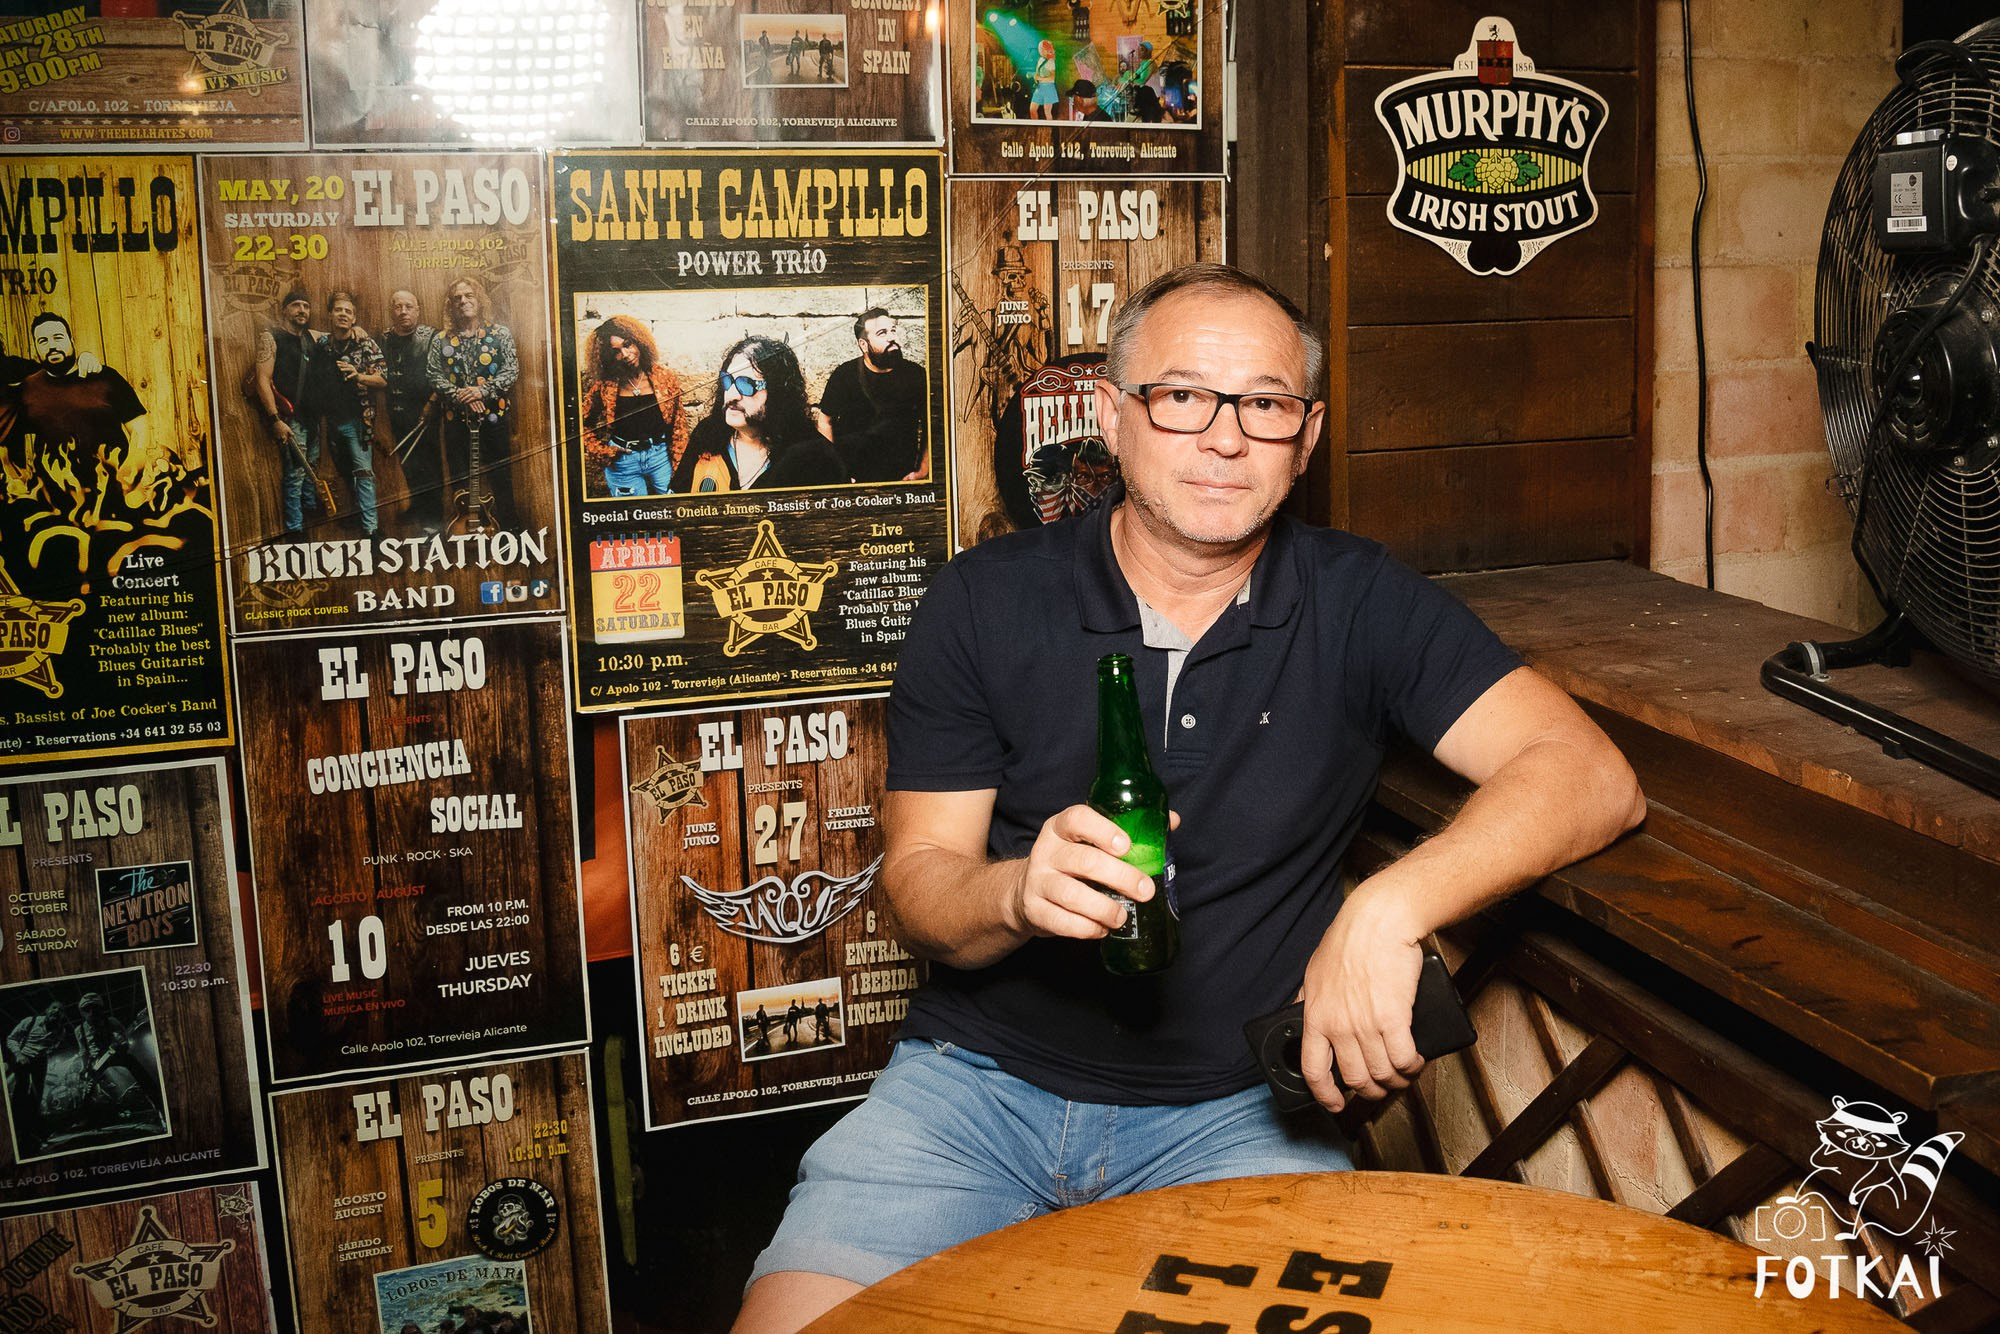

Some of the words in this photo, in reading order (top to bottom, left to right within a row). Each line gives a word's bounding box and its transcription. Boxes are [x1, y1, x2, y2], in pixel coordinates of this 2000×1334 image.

[33, 26, 105, 57] 28TH
[877, 18, 896, 42] IN
[862, 50, 911, 75] SPAIN
[1458, 60, 1475, 70] EST
[1515, 62, 1533, 72] 1856
[233, 68, 287, 87] MUSIC
[685, 117, 720, 127] CALLE
[721, 117, 758, 127] APOLO
[782, 117, 845, 128] TORREVIEJA
[847, 117, 898, 127] ALICANTE
[1395, 89, 1590, 150] MURPHY'S
[1001, 142, 1024, 158] Calle
[1029, 142, 1054, 161] Apolo
[1061, 142, 1084, 160] 102,
[1090, 142, 1137, 162] Torrevieja
[1141, 142, 1177, 159] Alicante
[219, 178, 299, 205] MAY,
[305, 175, 345, 200] 20
[351, 169, 405, 227] EL
[413, 167, 531, 227] PASO
[569, 168, 704, 242] SANTI
[718, 167, 928, 240] CAMPILLO
[224, 211, 340, 228] SATURDAY
[1017, 190, 1058, 241] EL
[1078, 189, 1159, 241] PASO
[1408, 190, 1487, 232] IRISH
[1493, 190, 1579, 232] STOUT
[234, 233, 329, 261] 22-30
[678, 250, 763, 278] POWER
[771, 243, 827, 276] TRÍO
[1062, 260, 1115, 271] PRESENTS
[1000, 301, 1029, 314] JUNE
[1067, 282, 1115, 345] 17
[997, 314, 1032, 327] JUNIO
[582, 510, 628, 525] Special
[633, 507, 672, 521] Guest:
[677, 505, 719, 518] Oneida
[767, 500, 811, 513] Bassist
[815, 498, 827, 511] of
[831, 497, 852, 509] Joe
[855, 494, 902, 507] Cocker's
[905, 492, 936, 504] Band
[871, 523, 903, 537] Live
[249, 538, 373, 583] ROCK
[378, 526, 549, 574] STATION
[600, 543, 673, 569] APRIL
[859, 541, 915, 556] Concert
[126, 554, 165, 569] Live
[112, 574, 180, 590] Concert
[613, 572, 662, 613] 22
[100, 593, 170, 608] Featuring
[174, 591, 194, 603] his
[354, 585, 456, 612] BAND
[727, 586, 753, 611] EL
[762, 582, 810, 607] PASO
[108, 612, 135, 624] new
[141, 609, 189, 622] album:
[245, 608, 285, 620] CLASSIC
[287, 606, 312, 618] ROCK
[313, 605, 349, 617] COVERS
[595, 612, 681, 633] SATURDAY
[89, 642, 150, 657] Probably
[155, 640, 177, 652] the
[182, 638, 211, 651] best
[98, 659, 136, 673] Blues
[141, 655, 205, 669] Guitarist
[318, 646, 370, 701] EL
[391, 637, 486, 695] PASO
[598, 653, 644, 673] 10:30
[650, 652, 689, 672] p.m.
[117, 675, 131, 687] in
[136, 673, 189, 688] Spain...
[590, 685, 602, 697] C/
[606, 683, 639, 696] Apolo
[643, 681, 662, 692] 102
[672, 675, 726, 690] Torrevieja
[729, 671, 780, 687] (Alicante)
[791, 663, 858, 680] Reservations
[860, 663, 878, 674] +34
[35, 729, 117, 747] Reservations
[119, 728, 141, 740] +34
[144, 726, 167, 738] 641
[170, 724, 185, 736] 32
[189, 722, 203, 734] 55
[207, 721, 222, 733] 03
[698, 720, 744, 772] EL
[764, 710, 849, 766] PASO
[307, 738, 472, 796] CONCIENCIA
[748, 779, 803, 794] PRESENTS
[43, 784, 143, 843] PASO
[430, 793, 524, 834] SOCIAL
[827, 805, 872, 818] FRIDAY
[686, 821, 717, 838] JUNE
[755, 801, 808, 866] 27
[824, 817, 876, 832] VIERNES
[683, 834, 721, 850] JUNIO
[363, 854, 398, 867] PUNK
[407, 850, 441, 863] ROCK
[449, 847, 473, 859] SKA
[120, 867, 161, 897] The
[8, 889, 65, 904] OCTUBRE
[103, 881, 191, 929] NEWTRON
[447, 903, 485, 917] FROM
[487, 901, 502, 914] 10
[505, 899, 530, 912] P.M.
[10, 902, 68, 917] OCTOBER
[15, 926, 67, 941] SÁBADO
[126, 912, 175, 948] BOYS
[426, 922, 468, 937] DESDE
[470, 919, 493, 931] LAS
[496, 914, 530, 928] 22:00
[17, 939, 79, 955] SATURDAY
[328, 915, 388, 984] 10
[669, 943, 680, 967] 6
[690, 945, 704, 963] €
[175, 962, 212, 976] 22:30
[465, 950, 531, 972] JUEVES
[161, 978, 197, 993] 10:30
[200, 976, 229, 991] p.m.
[438, 973, 533, 999] THURSDAY
[659, 967, 717, 998] TICKET
[861, 967, 919, 995] BEBIDA
[657, 1006, 666, 1029] 1
[676, 995, 728, 1026] DRINK
[341, 1042, 369, 1056] Calle
[371, 1040, 404, 1055] Apolo
[406, 1036, 427, 1048] 102,
[428, 1028, 481, 1046] Torrevieja
[483, 1023, 528, 1038] Alicante
[655, 1024, 732, 1058] INCLUDED
[352, 1090, 403, 1142] EL
[422, 1073, 514, 1132] PASO
[415, 1148, 465, 1165] PRESENTS
[333, 1191, 387, 1208] AGOSTO
[472, 1181, 504, 1216] LOBOS
[507, 1178, 526, 1190] DE
[529, 1180, 556, 1210] MAR
[333, 1203, 384, 1221] AUGUST
[417, 1178, 448, 1249] 5
[337, 1237, 382, 1252] SÁBADO
[339, 1244, 394, 1262] SATURDAY
[106, 1273, 138, 1301] EL
[150, 1262, 203, 1293] PASO
